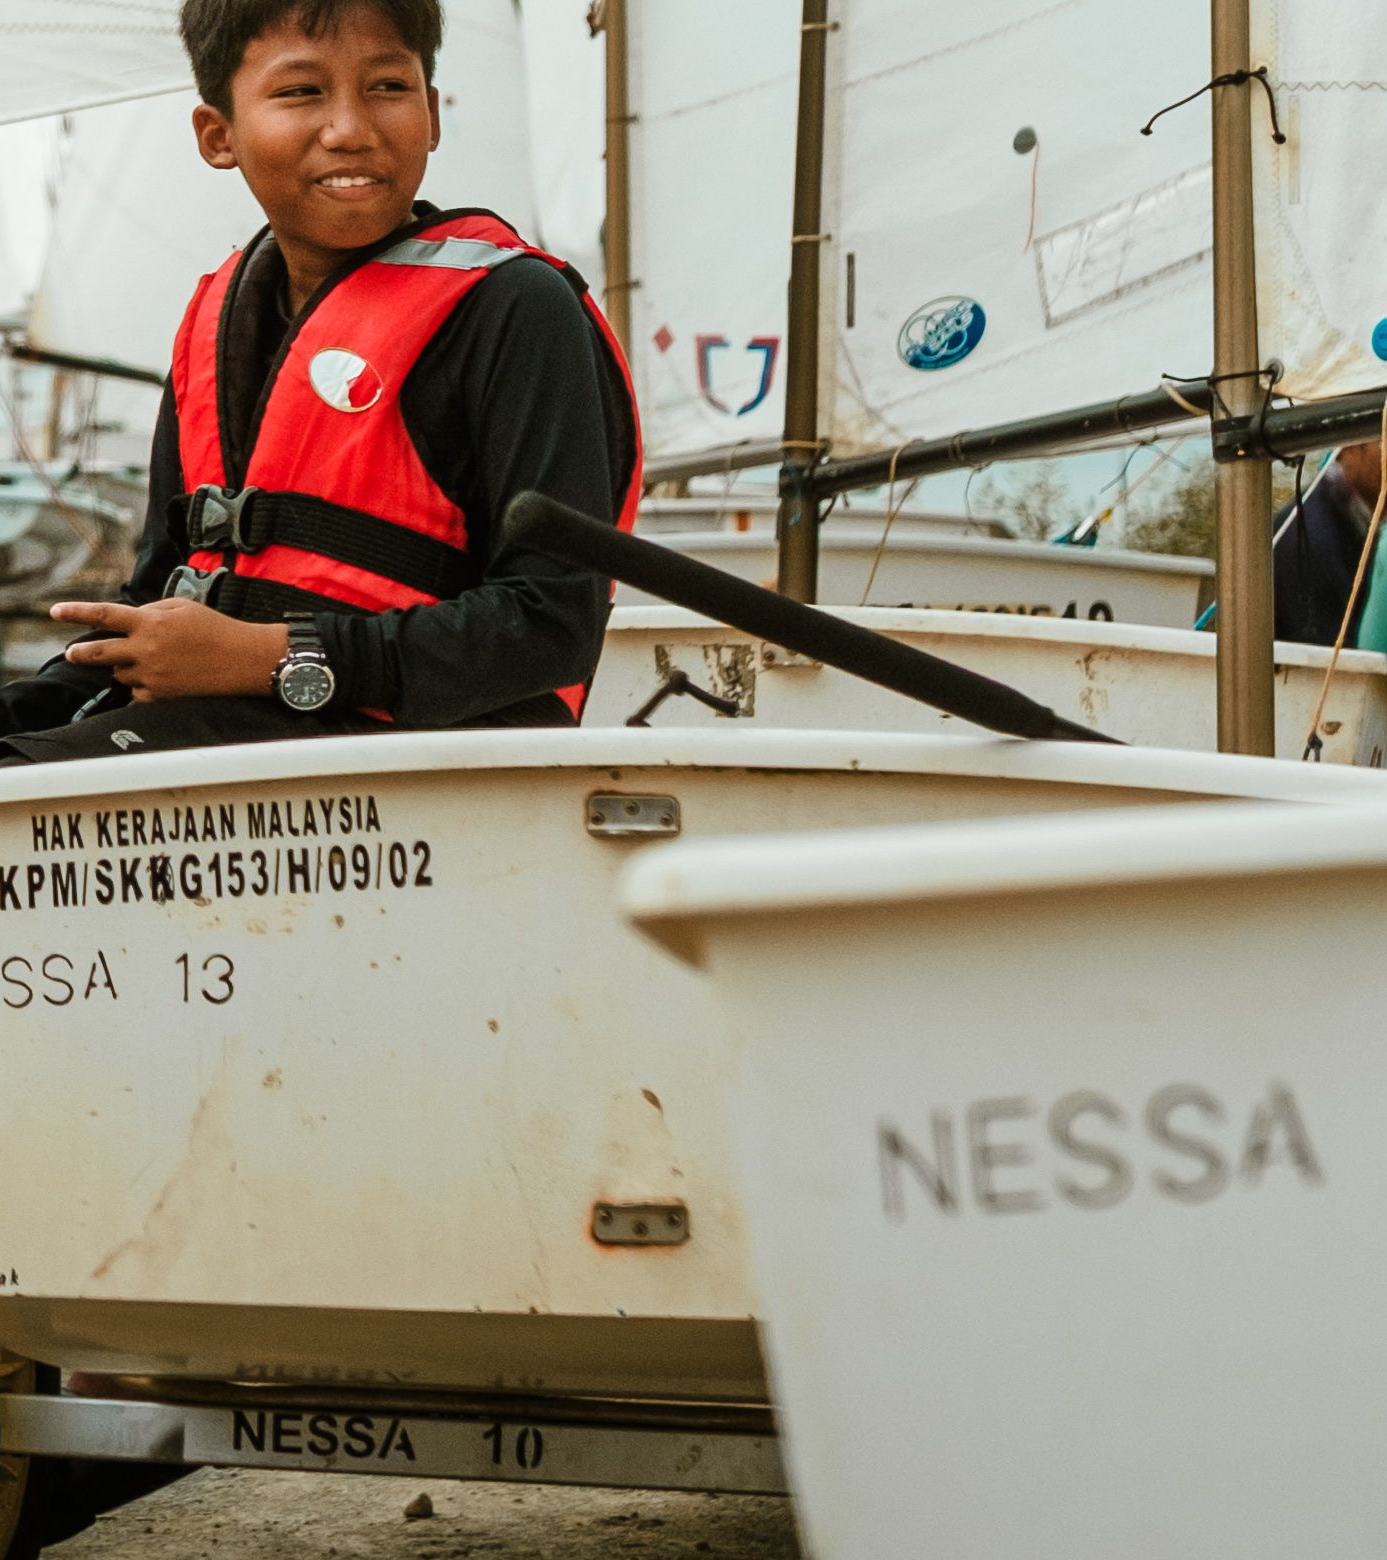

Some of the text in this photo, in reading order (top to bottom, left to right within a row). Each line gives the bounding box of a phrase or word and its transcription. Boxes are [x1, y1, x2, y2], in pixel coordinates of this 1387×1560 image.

[31, 795, 381, 852] HAK KERAJAAN MALAYSIA
[175, 952, 235, 1005] 13
[876, 1078, 1325, 1224] NESSA
[232, 1410, 545, 1469] NESSA 10
